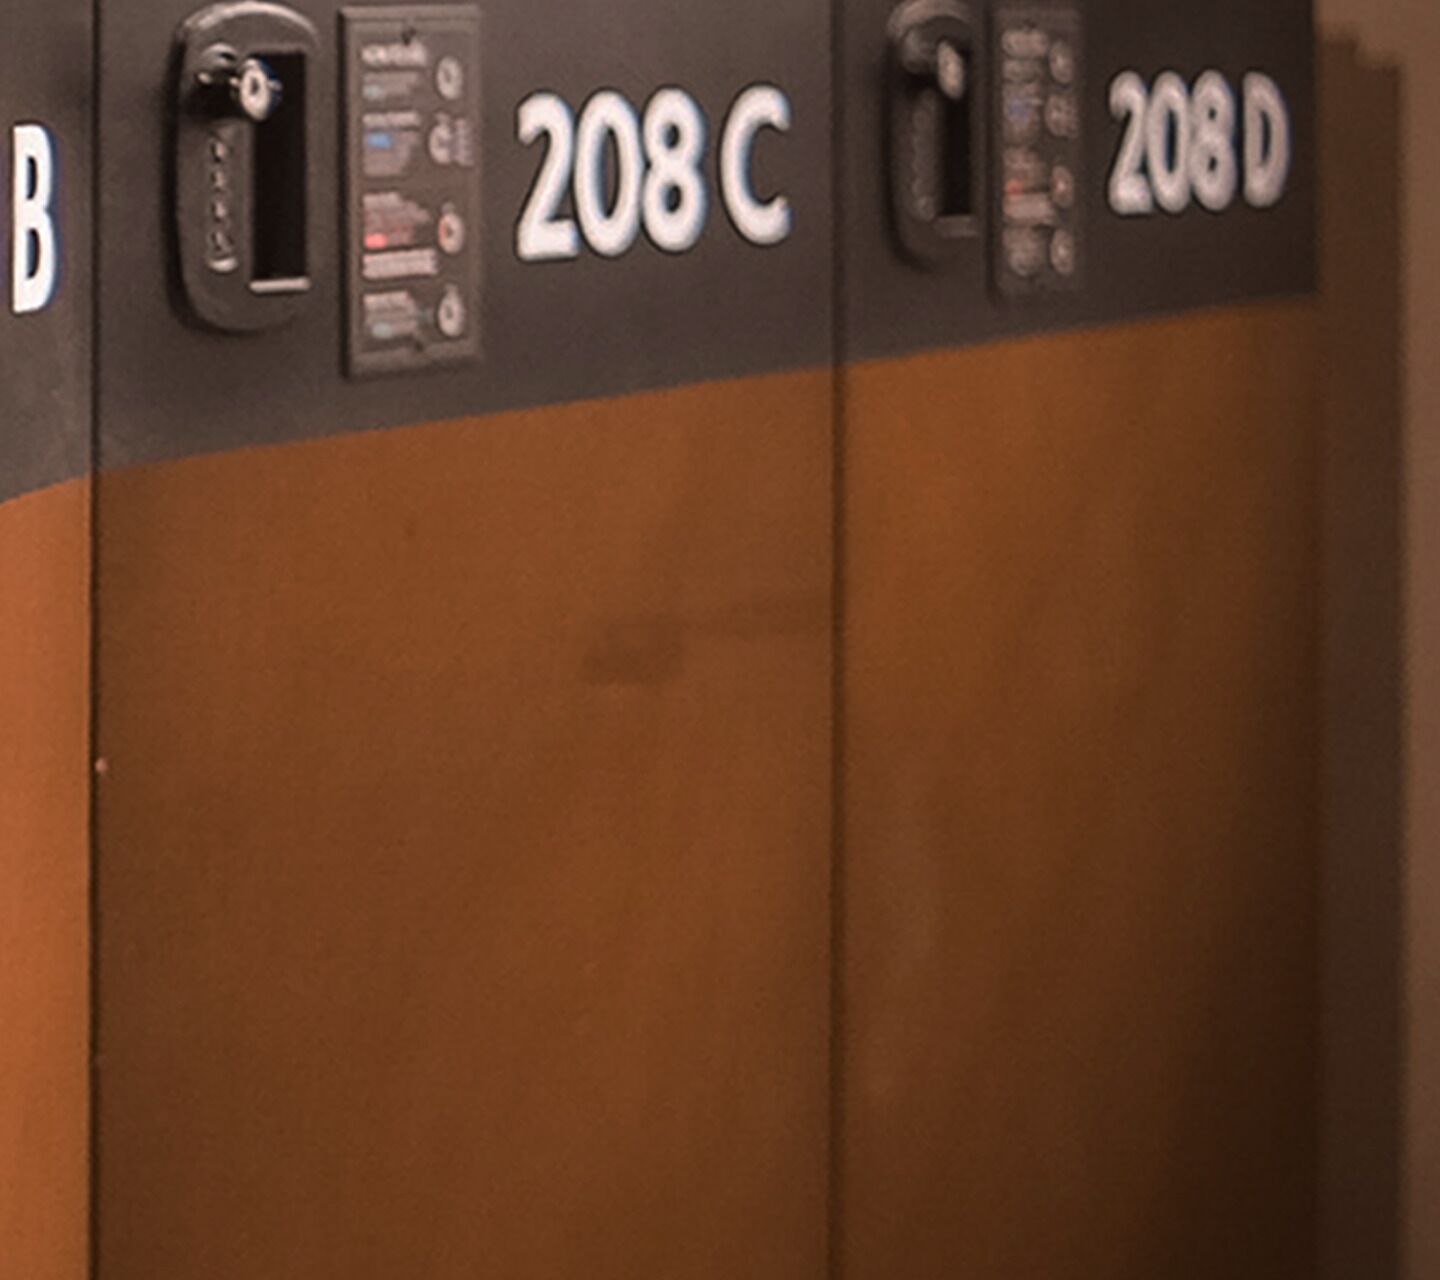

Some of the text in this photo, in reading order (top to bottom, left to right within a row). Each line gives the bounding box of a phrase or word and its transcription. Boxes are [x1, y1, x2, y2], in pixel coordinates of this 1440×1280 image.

[12, 124, 57, 313] B
[517, 88, 706, 260] 208
[720, 86, 791, 245] C
[1108, 70, 1236, 214] 208
[1244, 72, 1288, 207] D
